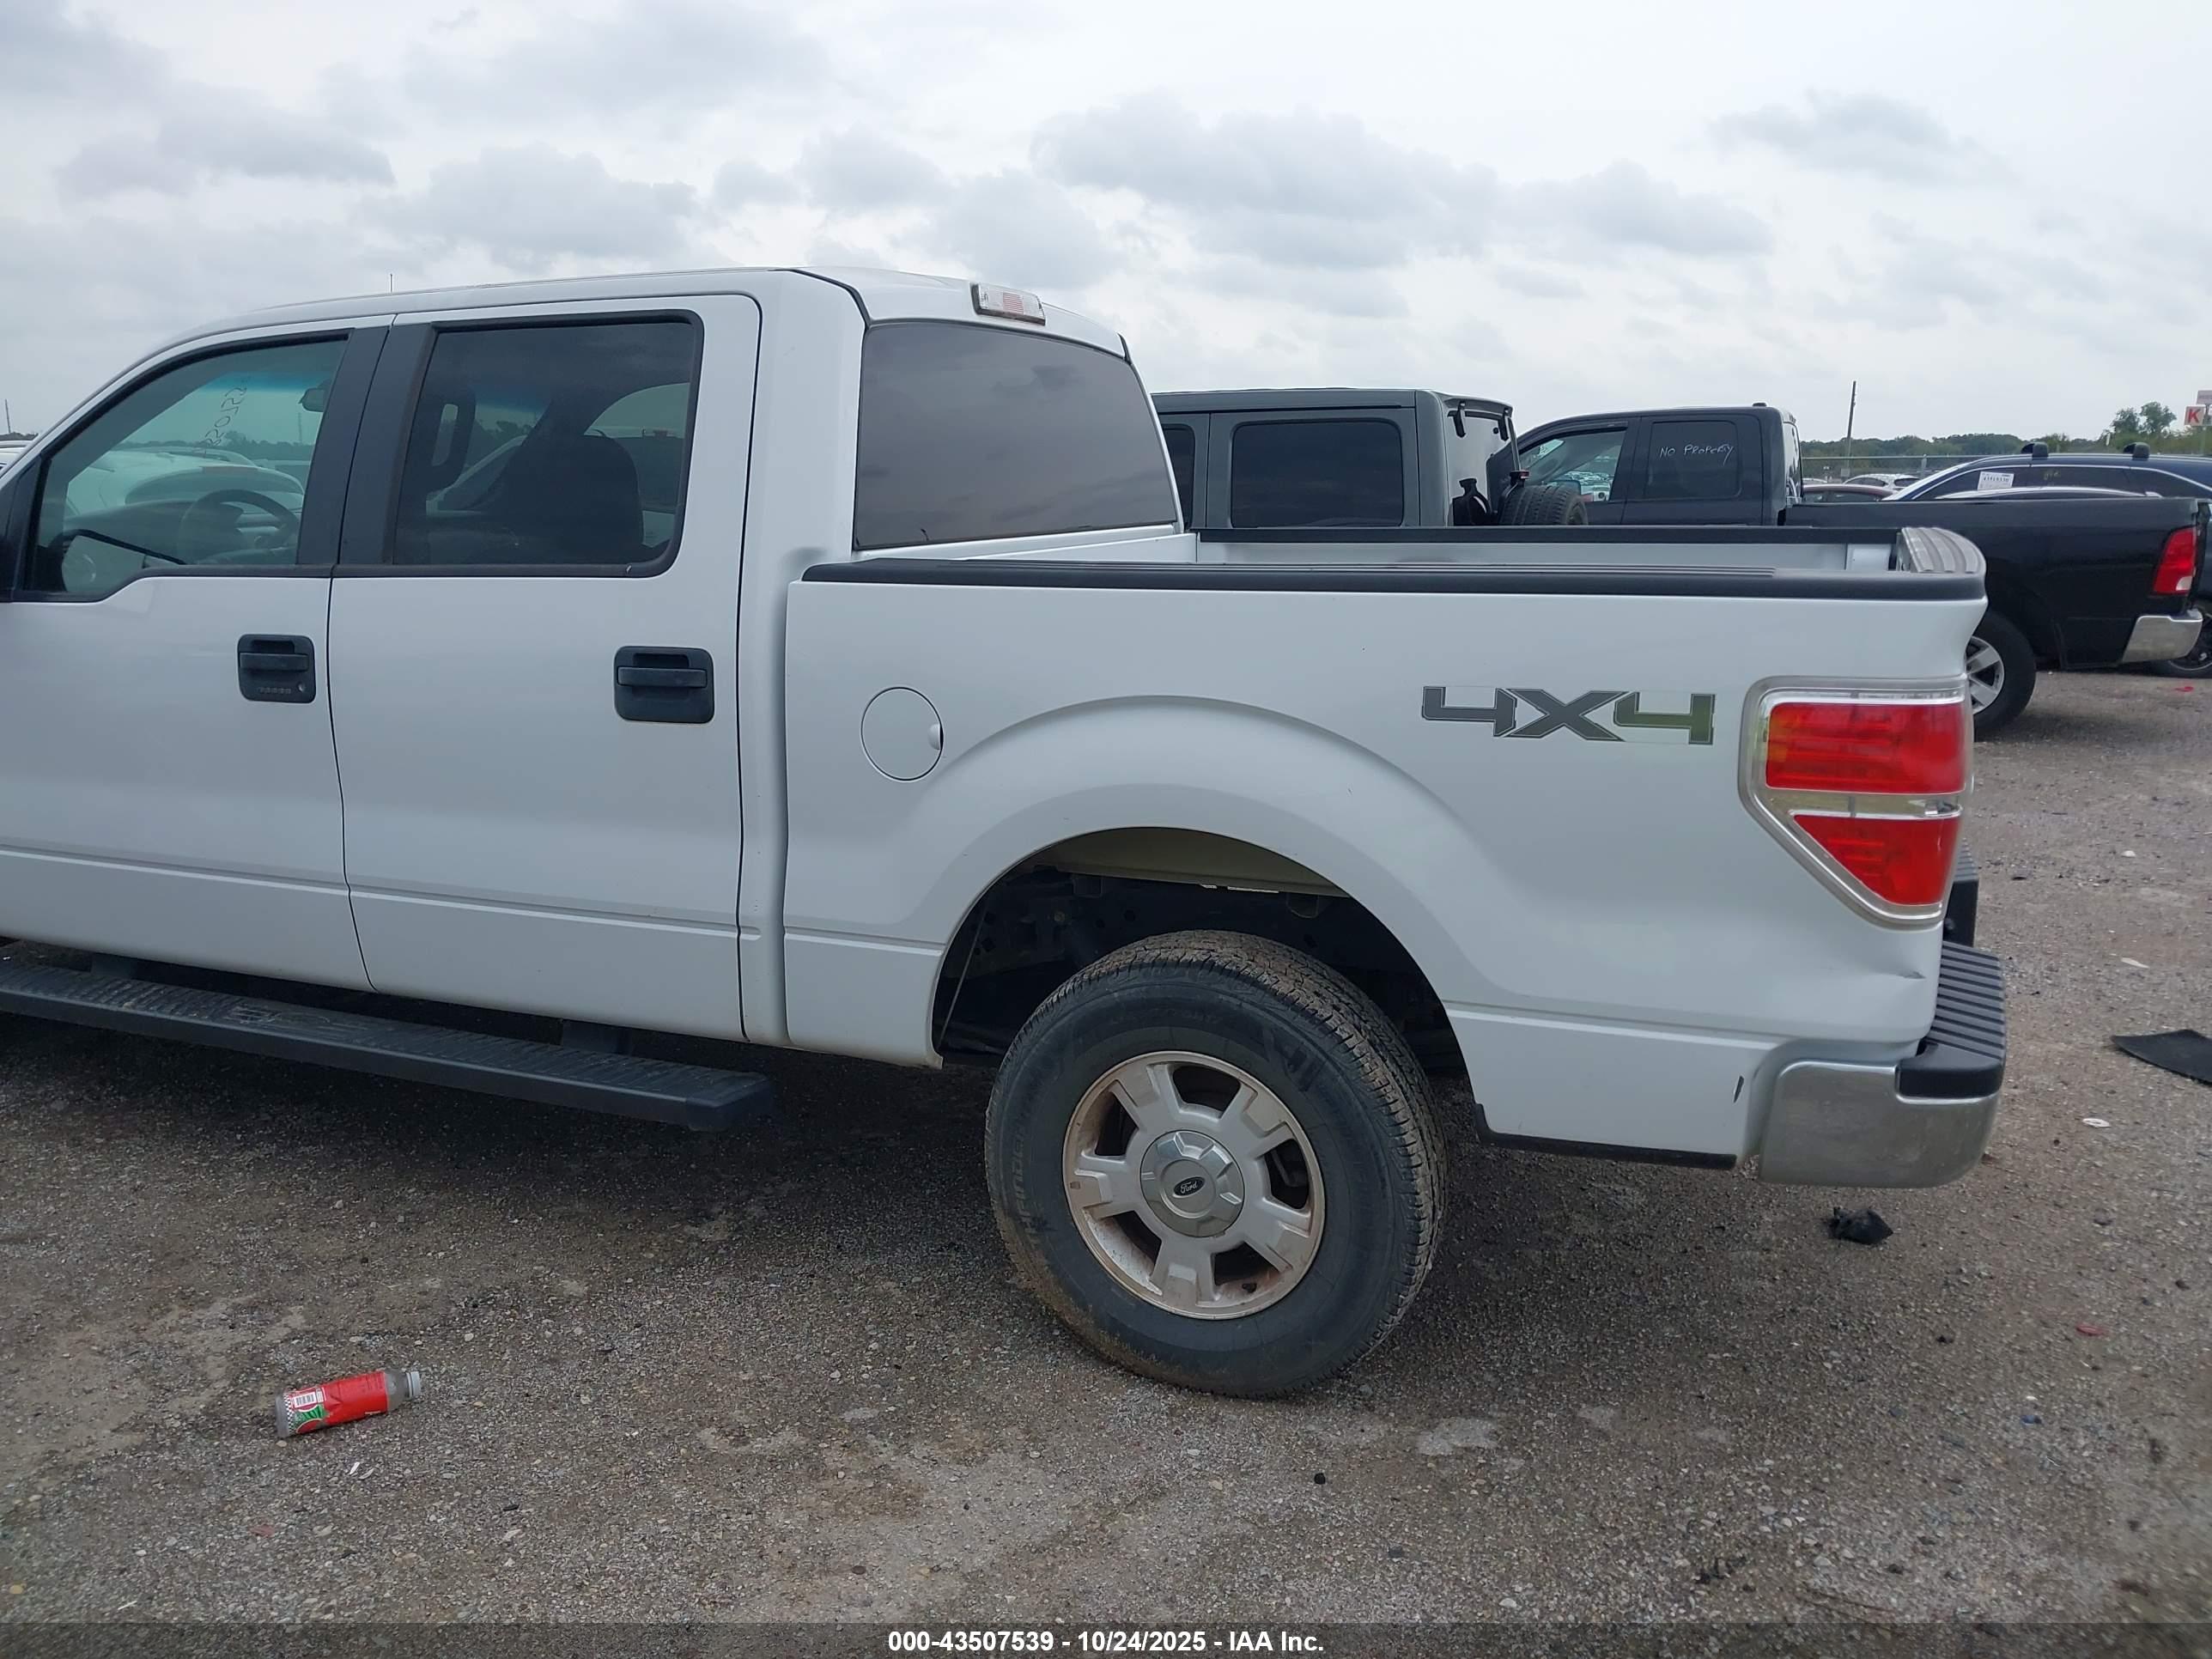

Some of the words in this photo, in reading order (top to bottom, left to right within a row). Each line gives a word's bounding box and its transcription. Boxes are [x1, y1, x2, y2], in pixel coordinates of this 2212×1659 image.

[2187, 408, 2201, 423] K
[1659, 447, 1676, 459] NO
[1421, 686, 1716, 745] 4X4
